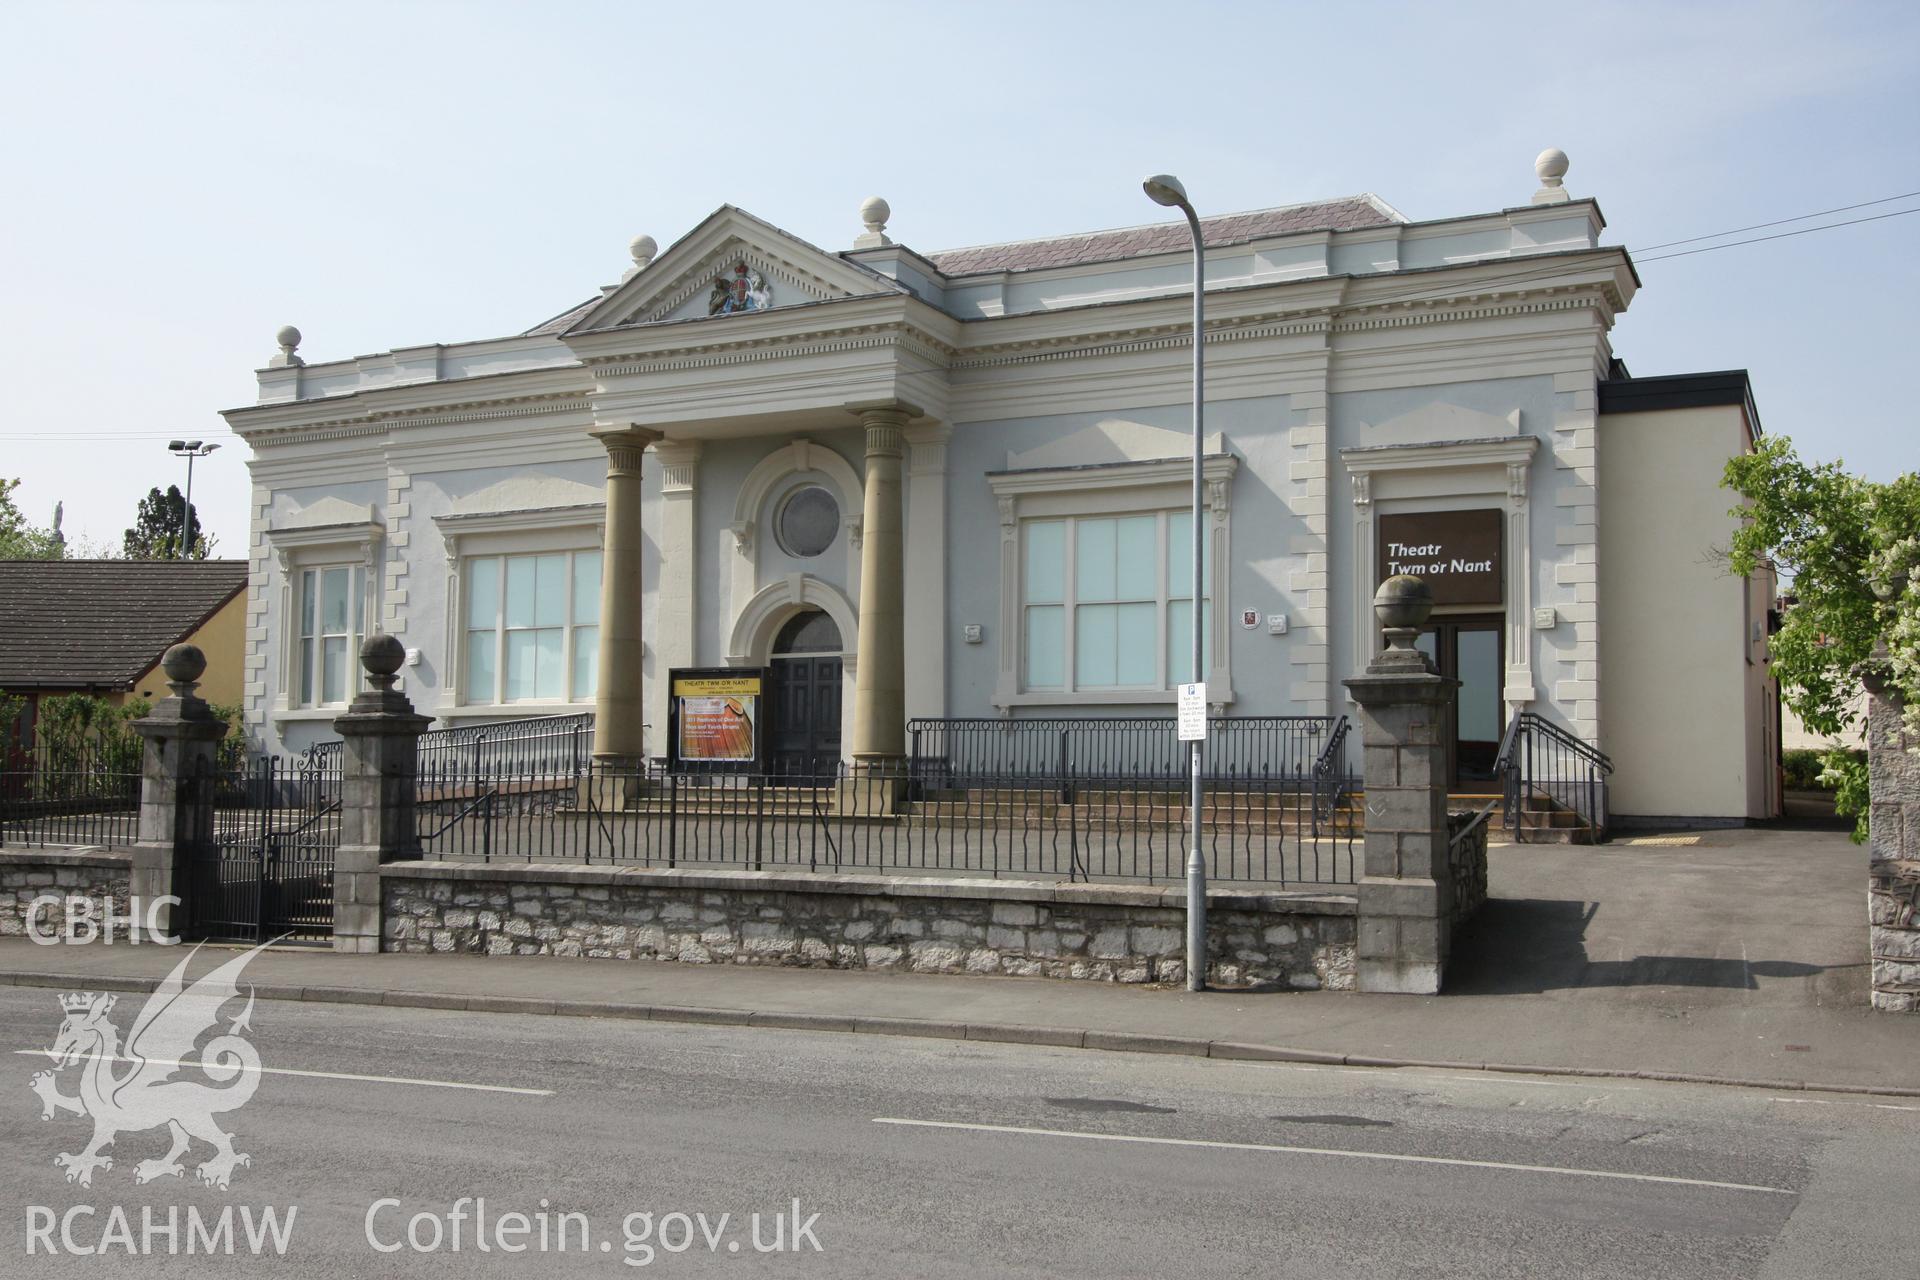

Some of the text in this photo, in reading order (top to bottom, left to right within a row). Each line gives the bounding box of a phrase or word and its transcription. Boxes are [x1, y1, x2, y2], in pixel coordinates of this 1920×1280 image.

[1388, 543, 1442, 557] Theatr
[1388, 559, 1492, 575] Twm o'r Nant
